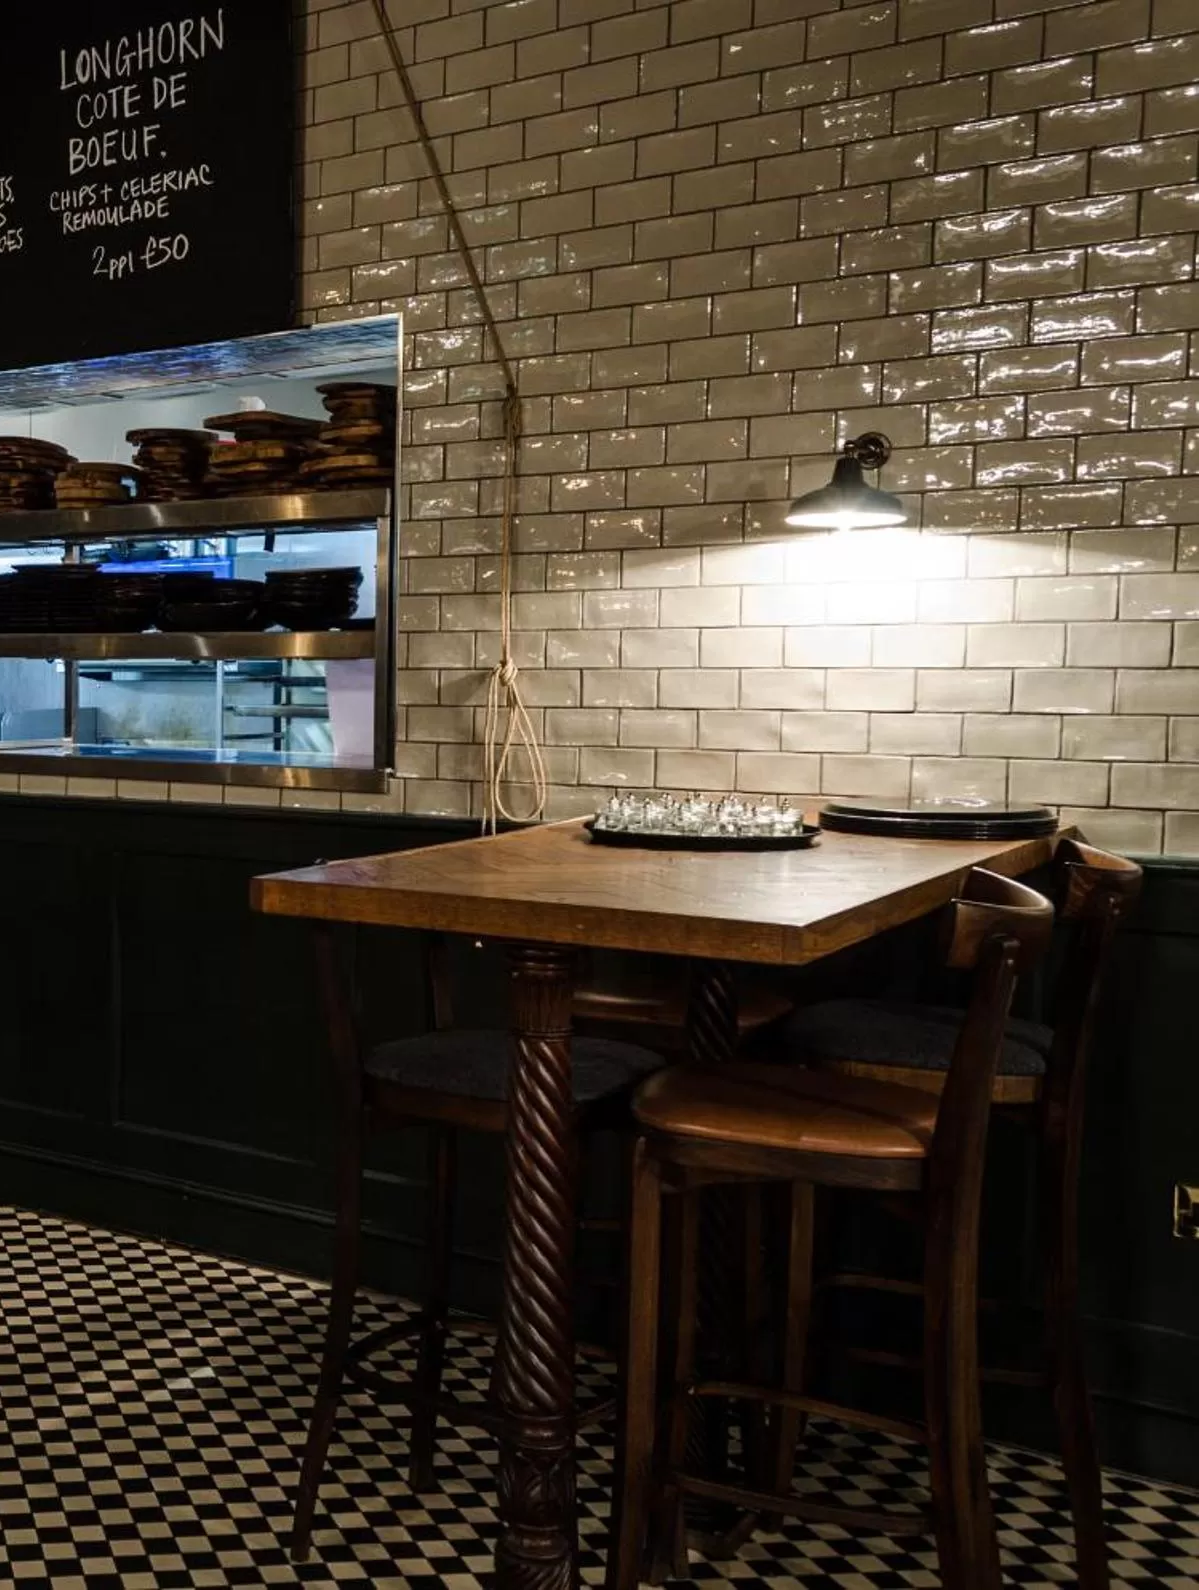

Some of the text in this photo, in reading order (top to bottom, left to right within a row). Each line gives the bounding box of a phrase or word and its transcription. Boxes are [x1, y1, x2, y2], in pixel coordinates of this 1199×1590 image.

[60, 8, 224, 90] LONGHORN
[77, 72, 187, 128] COTE DE
[69, 124, 167, 176] BOEUF.
[50, 183, 98, 211] CHIPS
[120, 164, 214, 201] CELERIAC
[63, 196, 170, 235] REMOULADE
[92, 233, 189, 280] 2ppl £50
